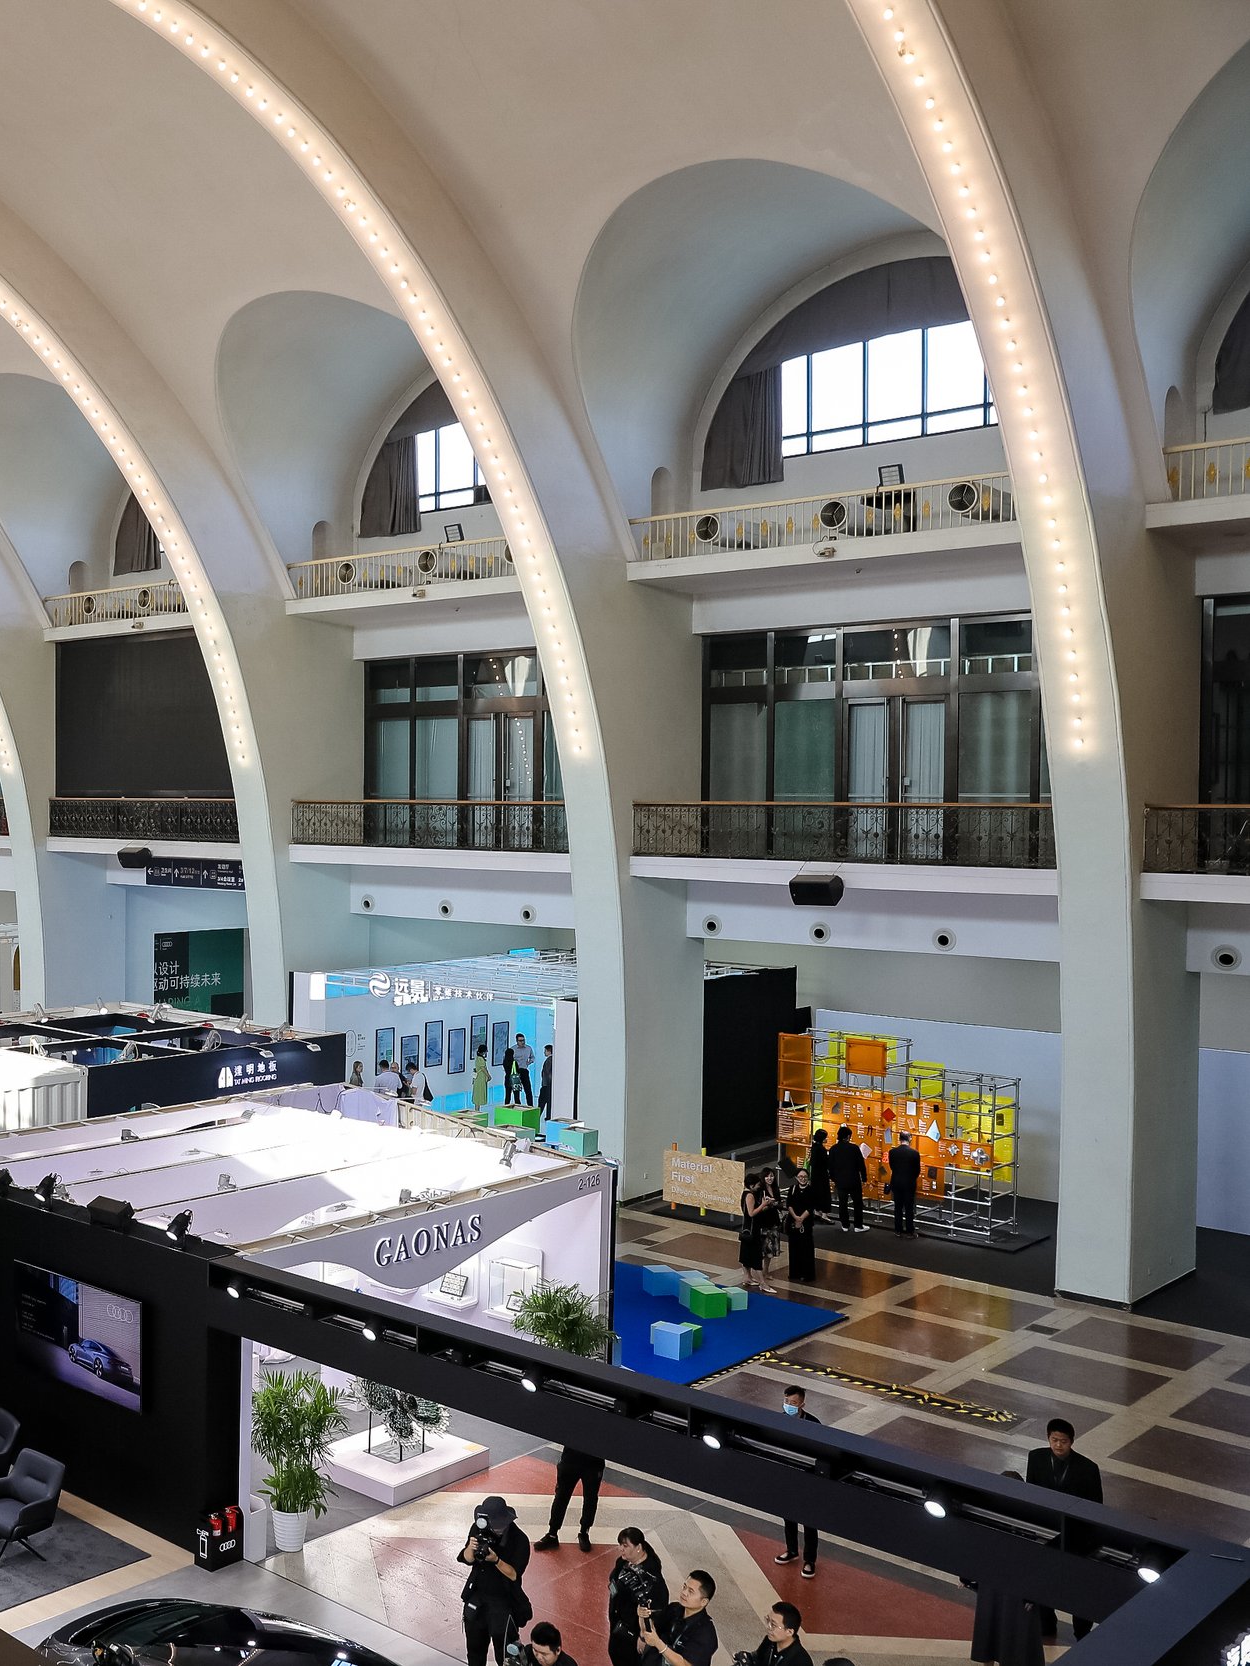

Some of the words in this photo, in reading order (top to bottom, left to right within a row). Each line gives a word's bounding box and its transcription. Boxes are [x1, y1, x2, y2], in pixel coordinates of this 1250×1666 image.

[394, 978, 425, 997] 远景
[671, 1158, 712, 1173] Material
[577, 1174, 600, 1191] 2-126
[671, 1171, 694, 1184] First
[374, 1213, 482, 1268] GAONAS
